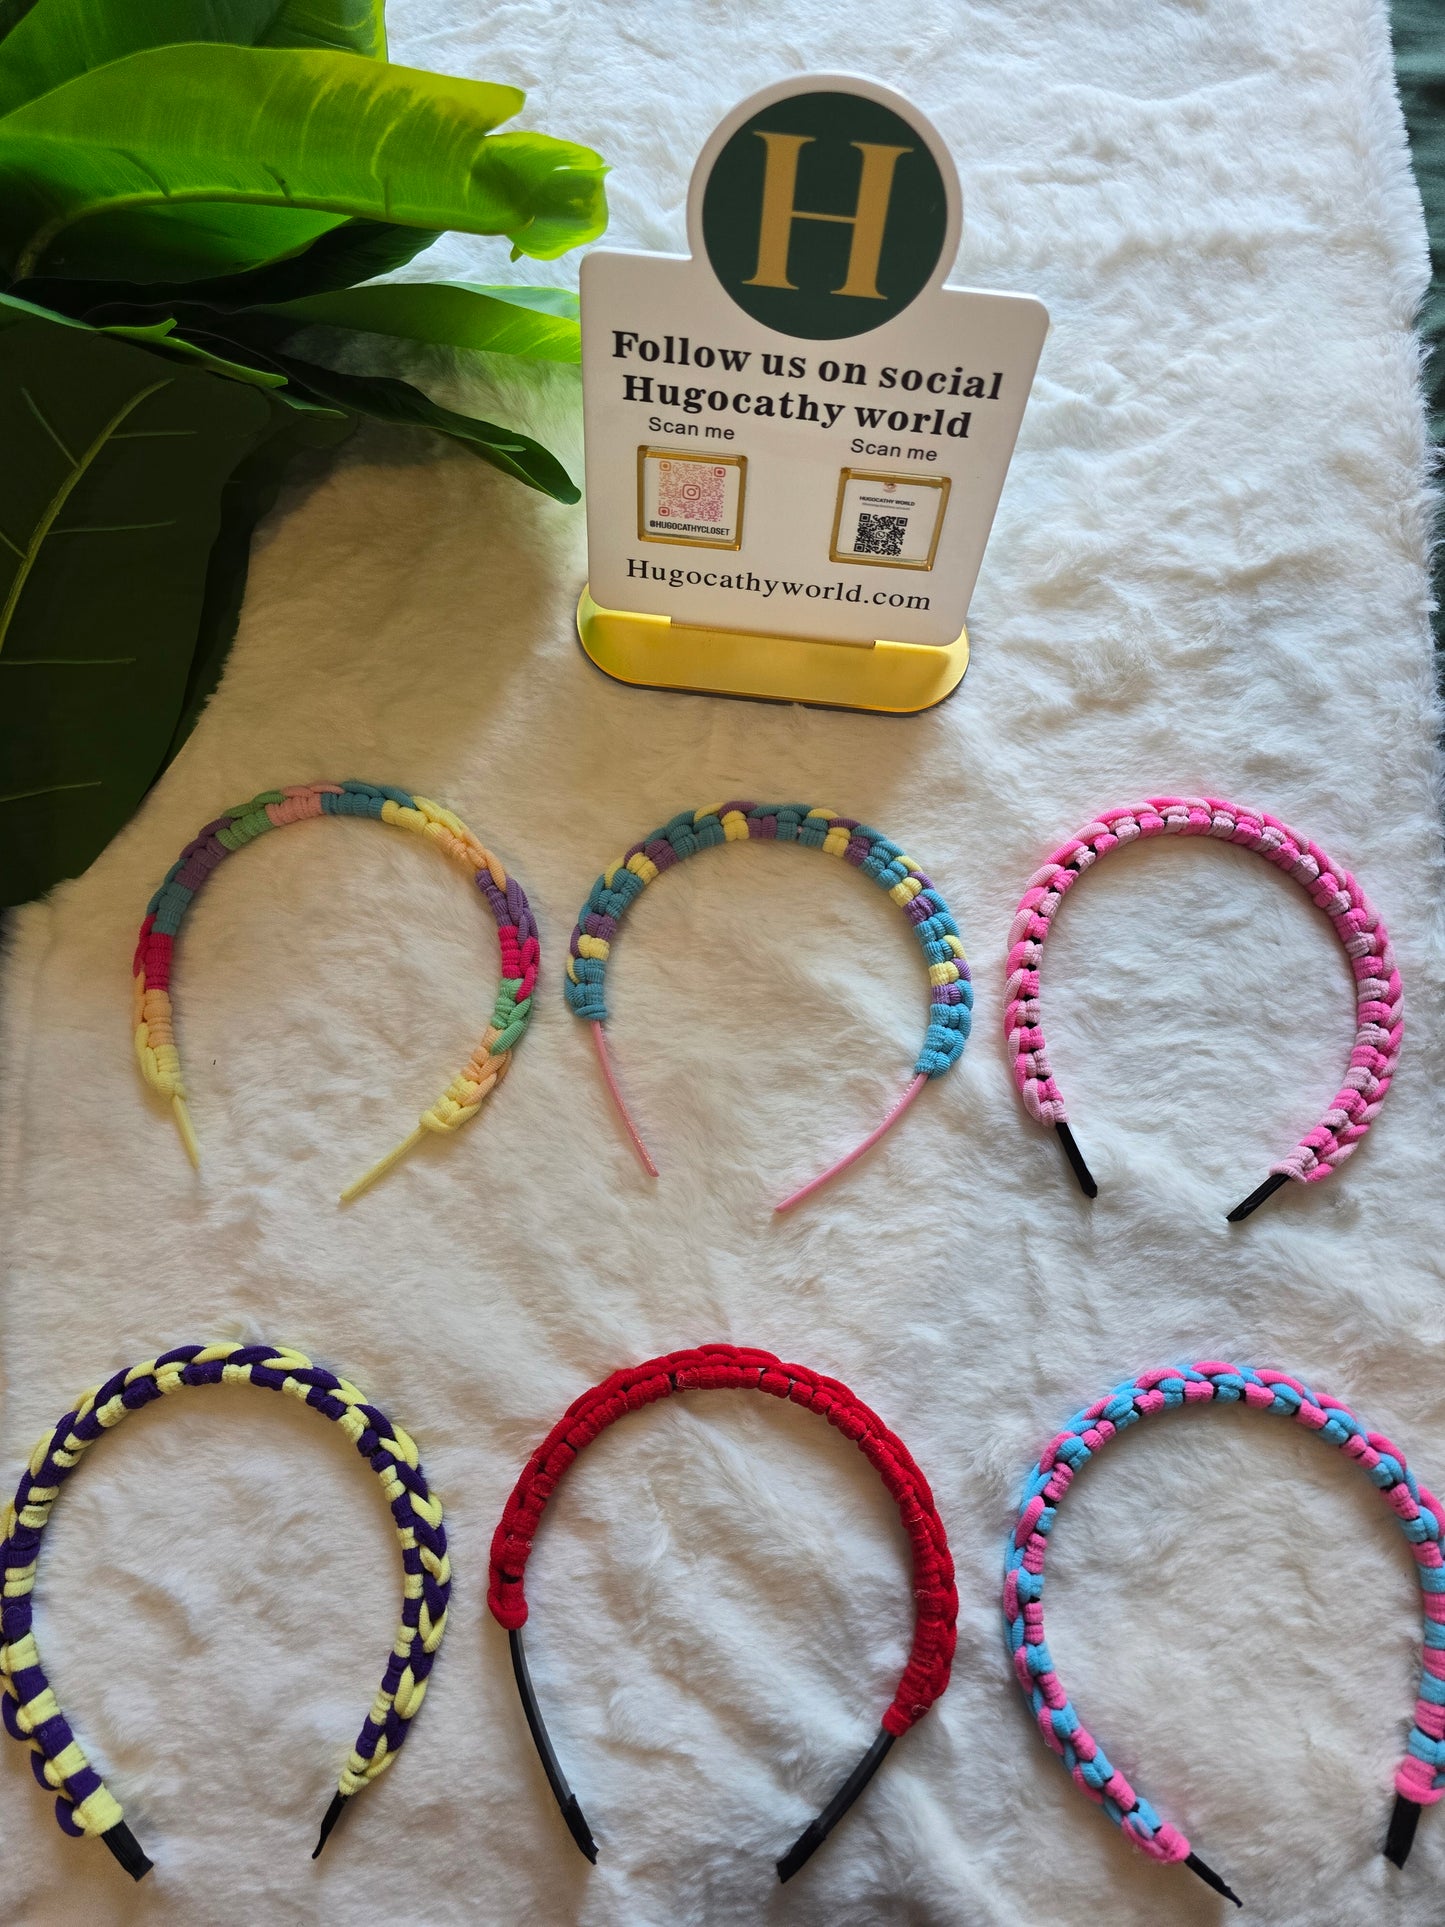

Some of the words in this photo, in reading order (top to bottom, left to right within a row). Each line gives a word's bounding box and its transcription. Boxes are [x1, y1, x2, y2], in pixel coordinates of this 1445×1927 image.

[742, 131, 914, 300] H
[612, 330, 752, 372] Follow
[761, 353, 806, 378] us
[818, 360, 867, 385] on
[878, 367, 1003, 400] social
[622, 374, 846, 429] Hugocathy
[854, 406, 972, 439] world
[648, 416, 699, 437] Scan
[704, 426, 735, 440] me
[850, 438, 901, 458] Scan
[906, 447, 938, 461] me
[859, 495, 894, 504] HUGOCATHY
[895, 499, 916, 507] WORLD
[649, 520, 731, 536] @HUGOCATHYCLOSET
[626, 558, 931, 611] Hugocathyworld.com
